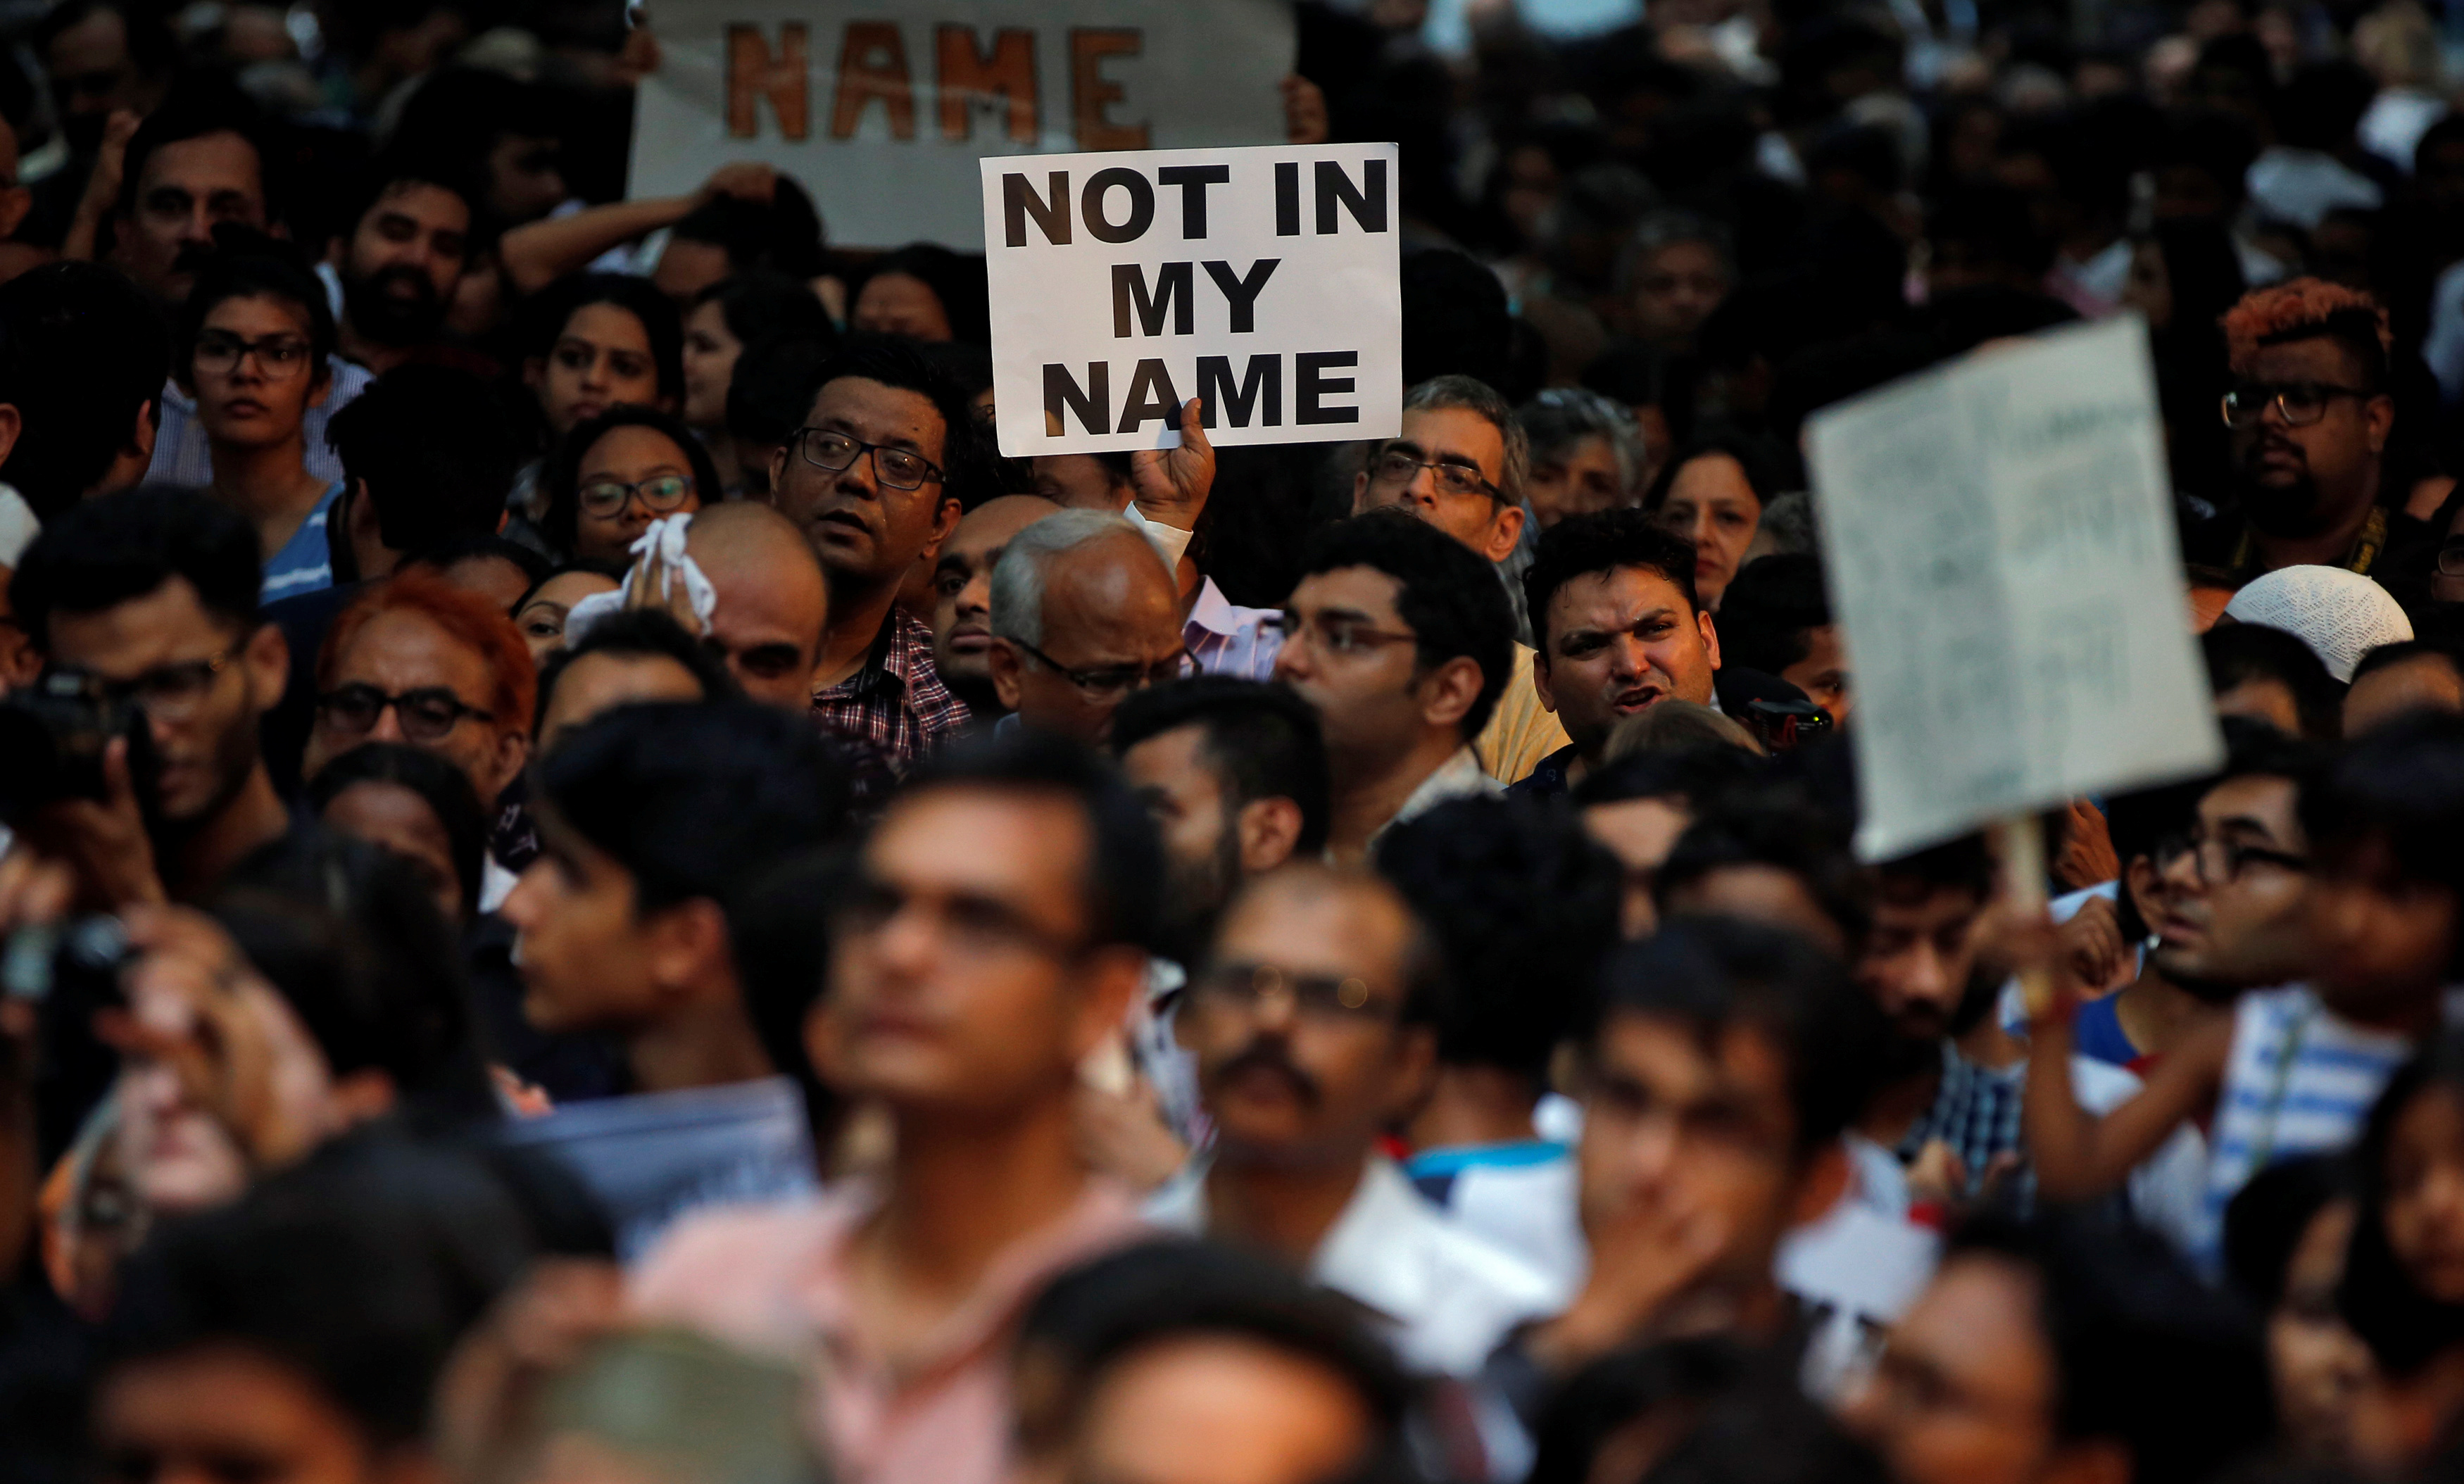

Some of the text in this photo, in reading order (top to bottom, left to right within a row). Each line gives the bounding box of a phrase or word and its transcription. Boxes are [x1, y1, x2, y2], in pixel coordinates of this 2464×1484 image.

[725, 24, 1153, 150] NAME
[1002, 159, 1388, 248] NOT IN
[1111, 258, 1281, 339] MY
[1043, 351, 1359, 437] NAME
